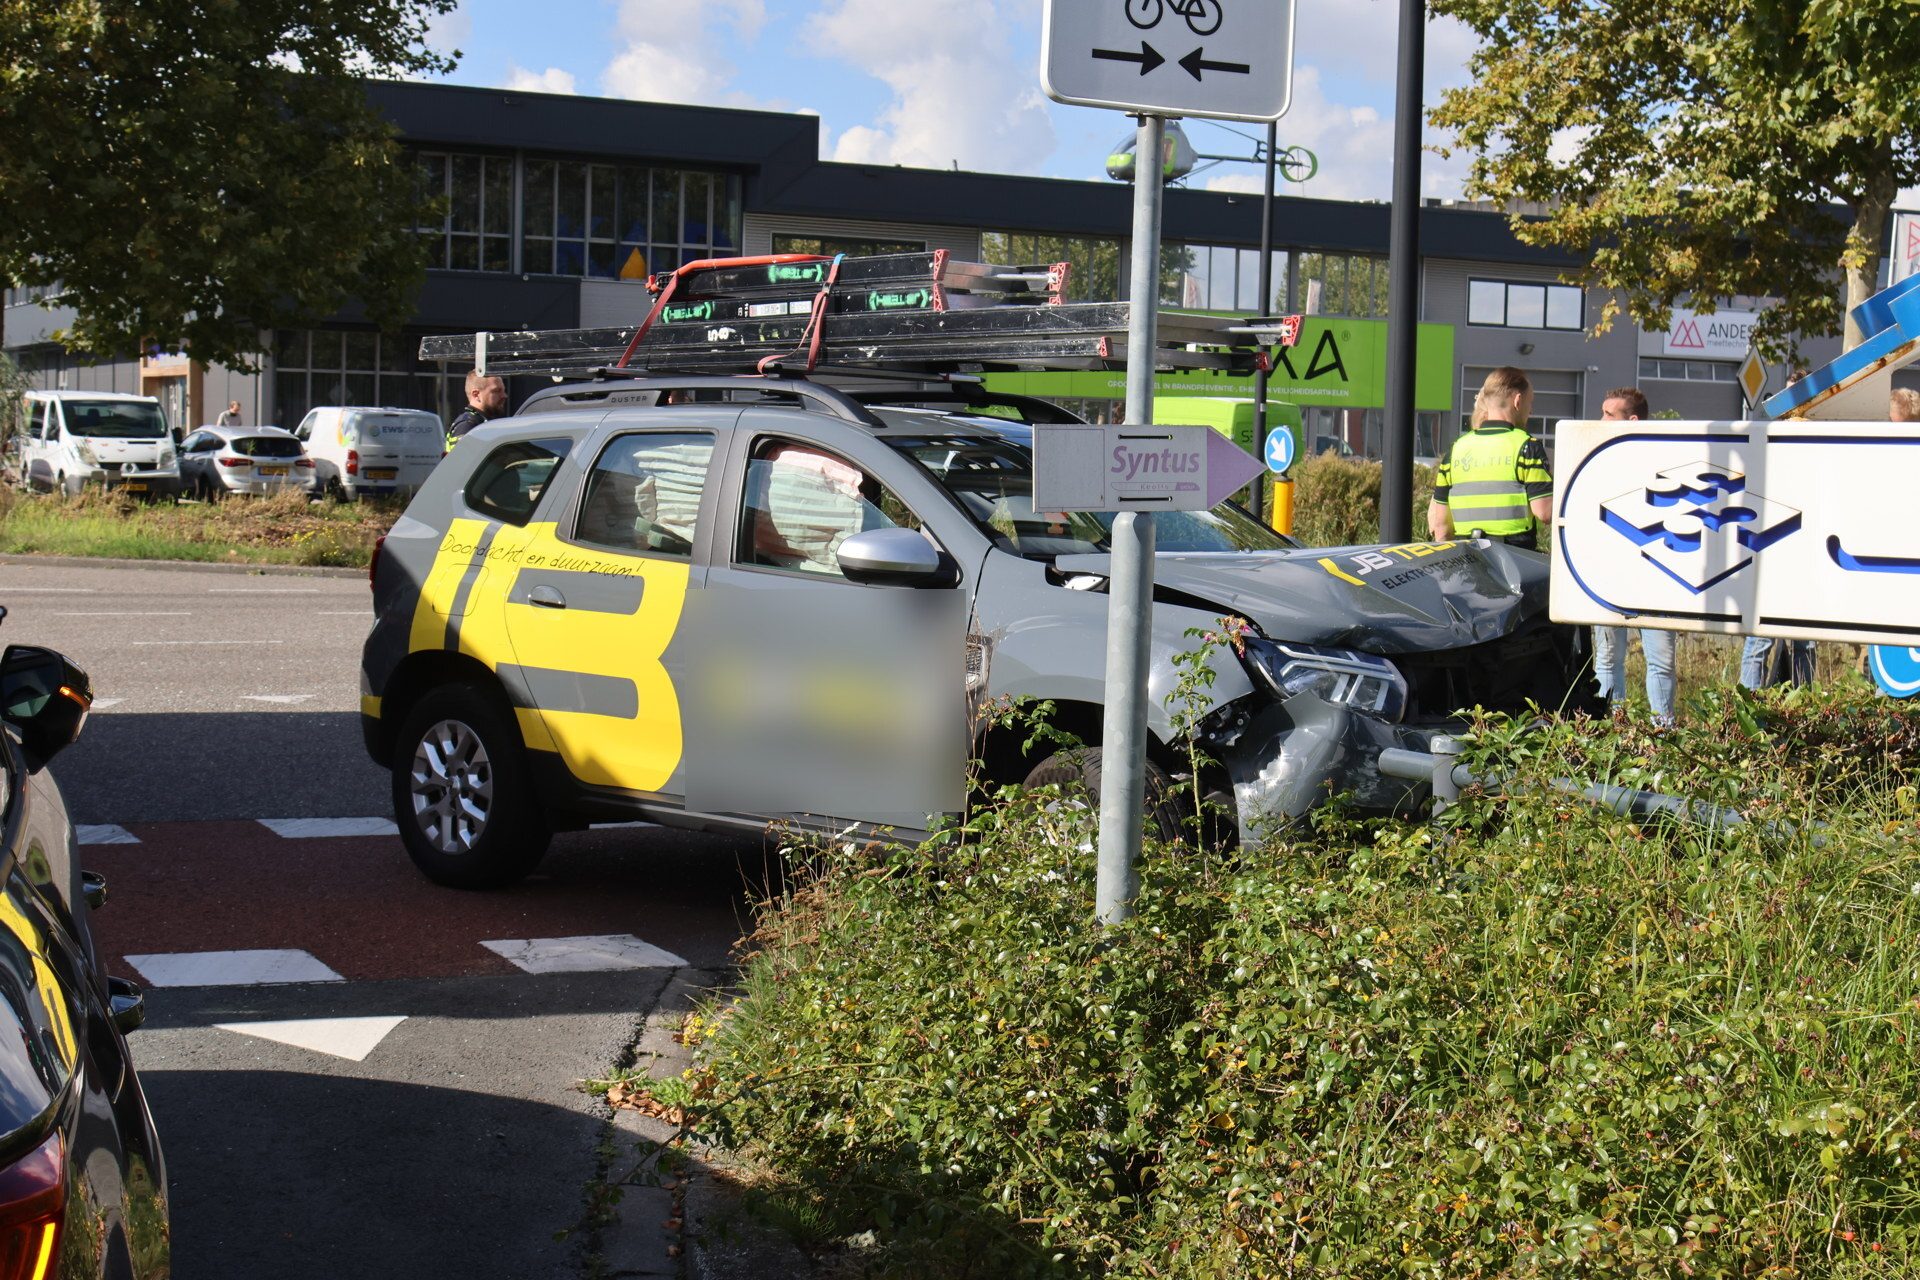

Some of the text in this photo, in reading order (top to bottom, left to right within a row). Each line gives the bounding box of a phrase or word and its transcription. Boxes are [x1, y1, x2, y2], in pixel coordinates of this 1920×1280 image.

[610, 395, 648, 403] DUSTER
[1111, 445, 1200, 481] Syntus
[439, 533, 646, 579] Doordacht en duurzaam!
[1381, 553, 1477, 590] ELEKTROTECHNIEK
